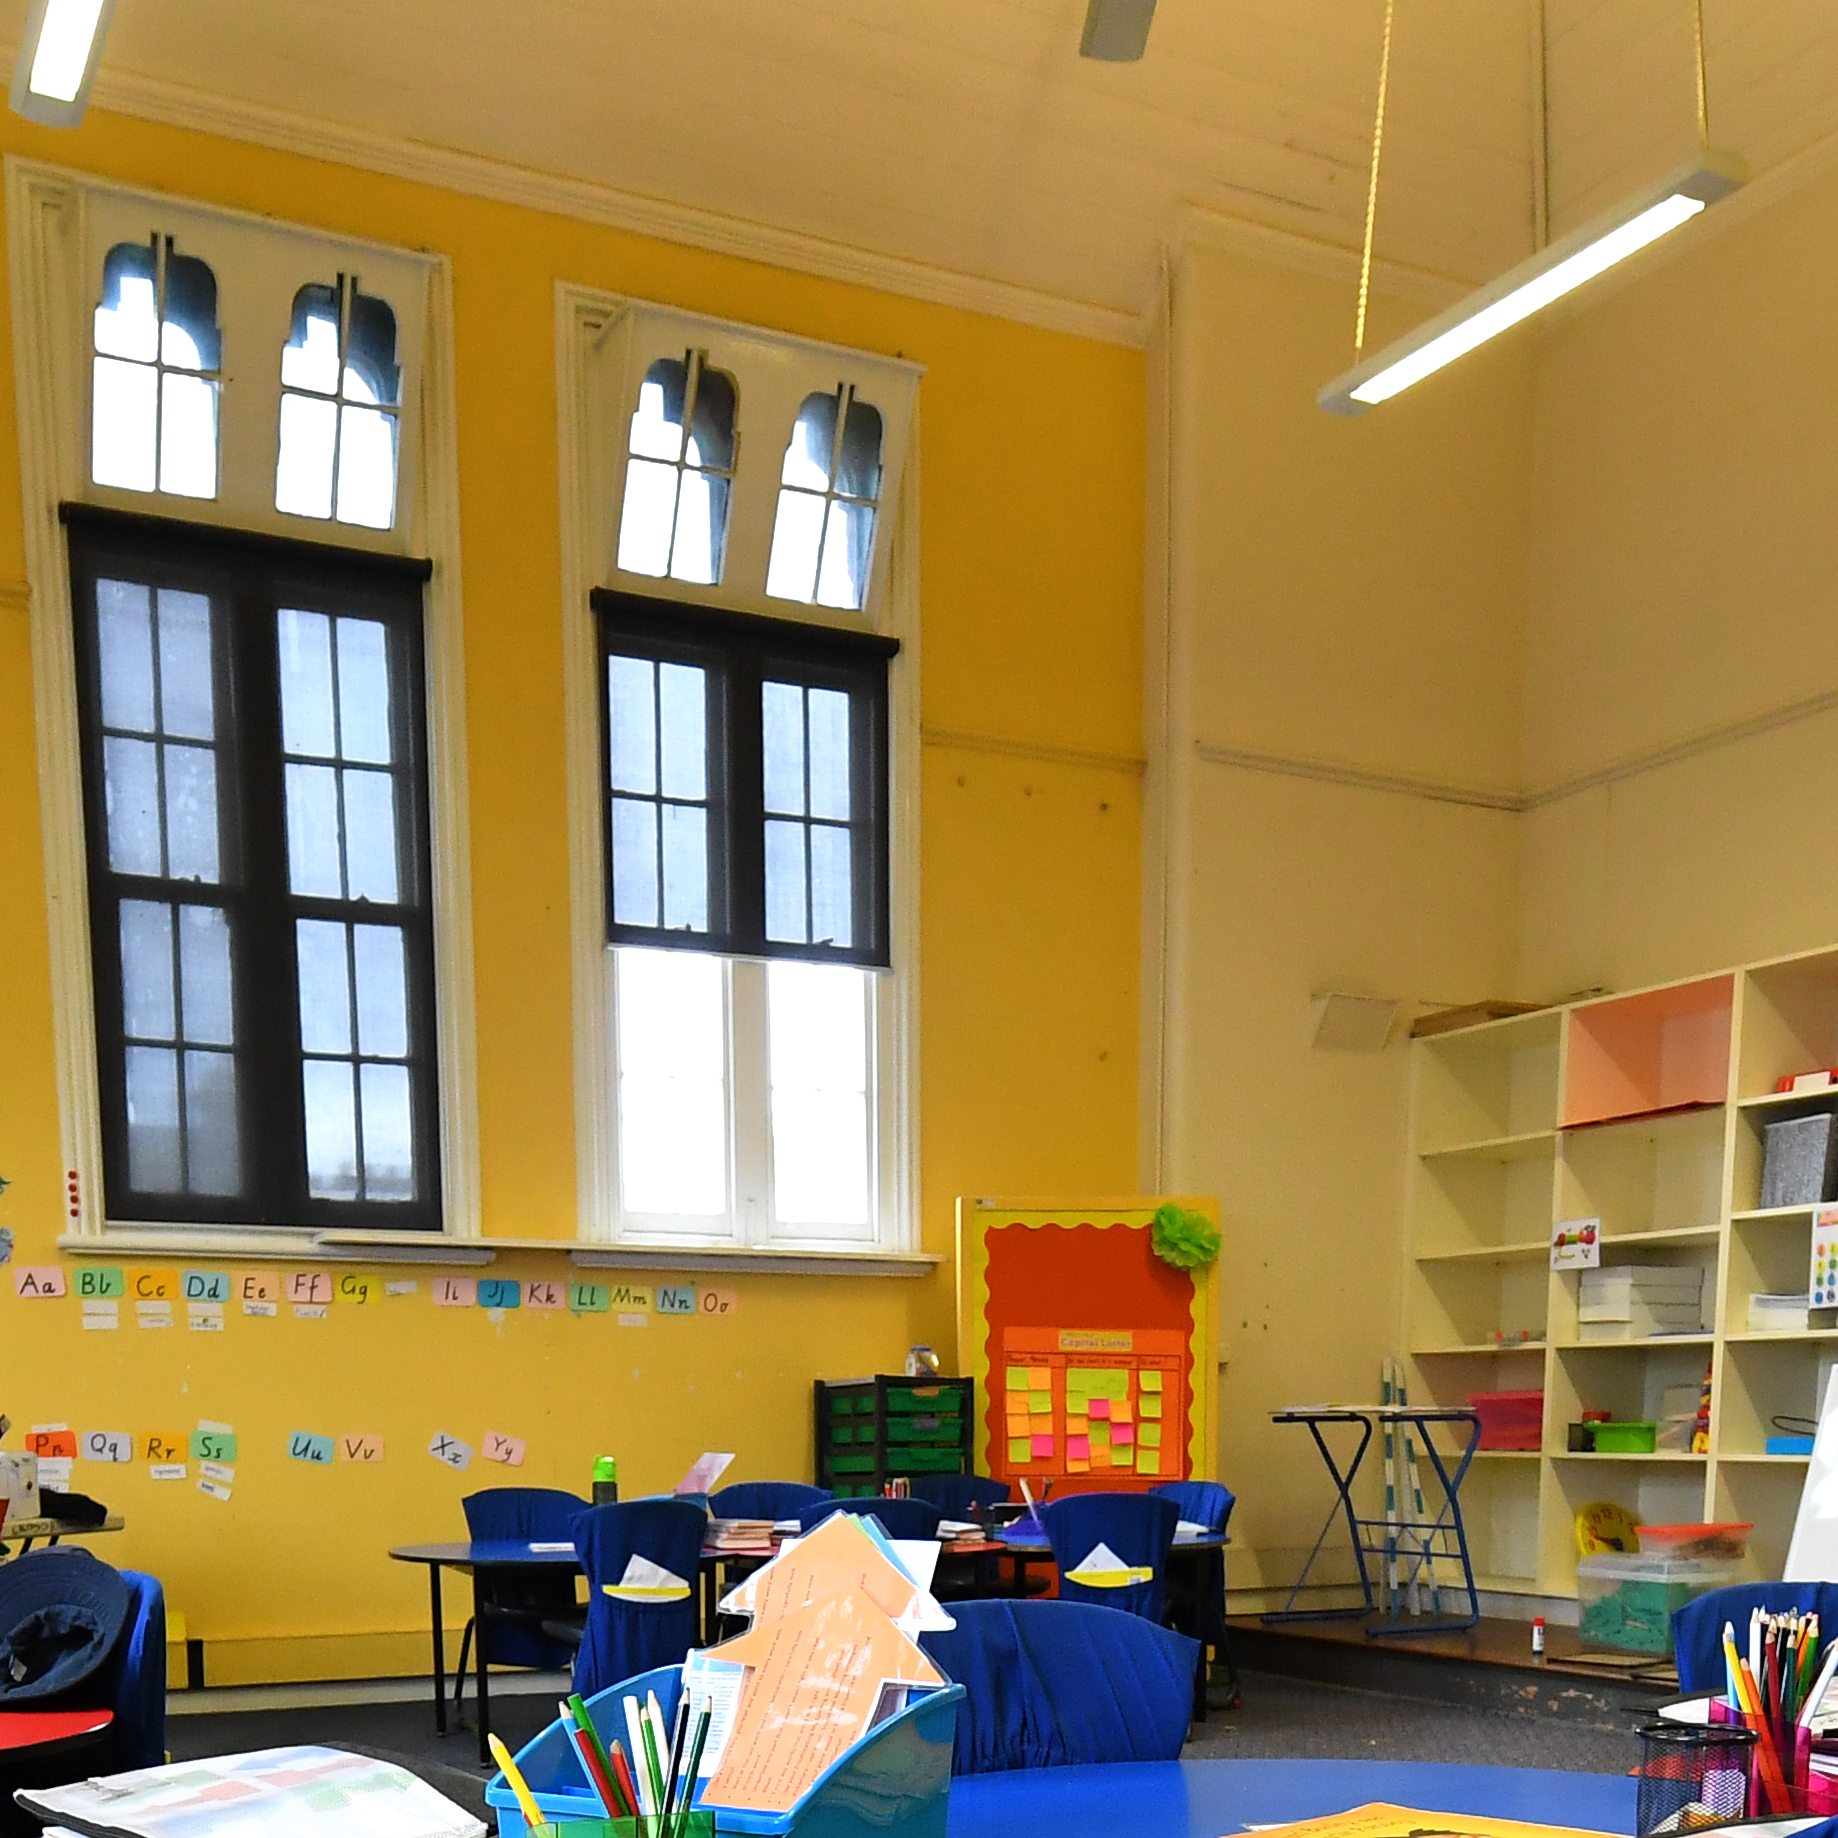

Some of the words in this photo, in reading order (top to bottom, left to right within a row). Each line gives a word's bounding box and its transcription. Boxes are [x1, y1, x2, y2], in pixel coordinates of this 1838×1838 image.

[20, 1274, 56, 1295] Aa
[82, 1273, 111, 1294] Bb
[136, 1275, 165, 1297] Cc
[187, 1276, 220, 1299] Dd
[243, 1277, 266, 1299] Ee
[294, 1273, 321, 1303] Ff
[341, 1275, 368, 1304] Gg
[528, 1284, 557, 1304] Kk
[578, 1284, 597, 1307] Ll
[613, 1288, 647, 1305] Mm
[661, 1289, 691, 1310] Nn
[704, 1293, 730, 1313] Oo
[90, 1433, 118, 1463] Qq
[147, 1437, 175, 1460] Rr
[199, 1436, 223, 1459] Ss
[292, 1436, 323, 1461] Uu
[346, 1438, 375, 1460] Vv
[431, 1435, 462, 1464] Xx
[495, 1436, 514, 1462] Yy
[1602, 1507, 1613, 1520] 12
